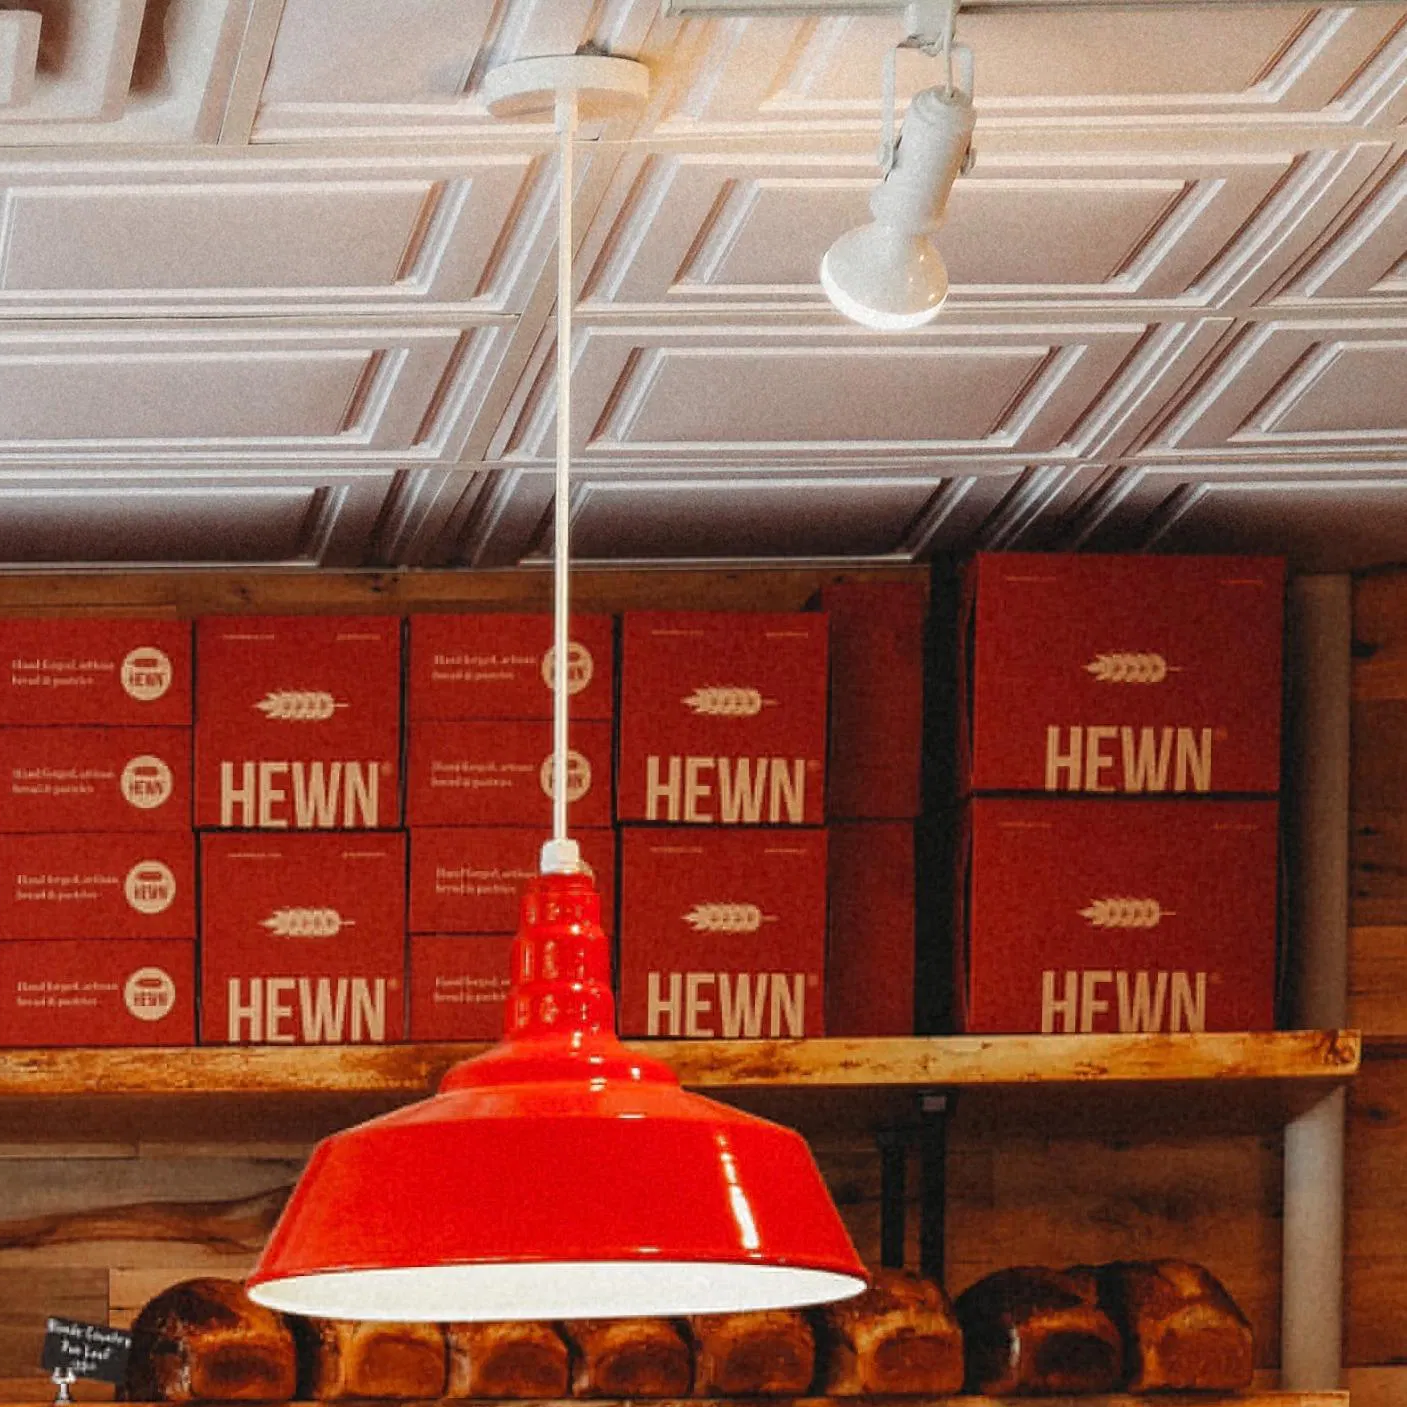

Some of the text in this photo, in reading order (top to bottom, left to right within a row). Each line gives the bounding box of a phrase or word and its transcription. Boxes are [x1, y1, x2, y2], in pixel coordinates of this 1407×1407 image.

[646, 756, 804, 823] HEWN
[1044, 725, 1212, 792] HEWN
[220, 762, 378, 828] HEWN
[229, 978, 385, 1043] HEWN
[648, 972, 804, 1038] HEWN
[1042, 971, 1206, 1033] HEWN
